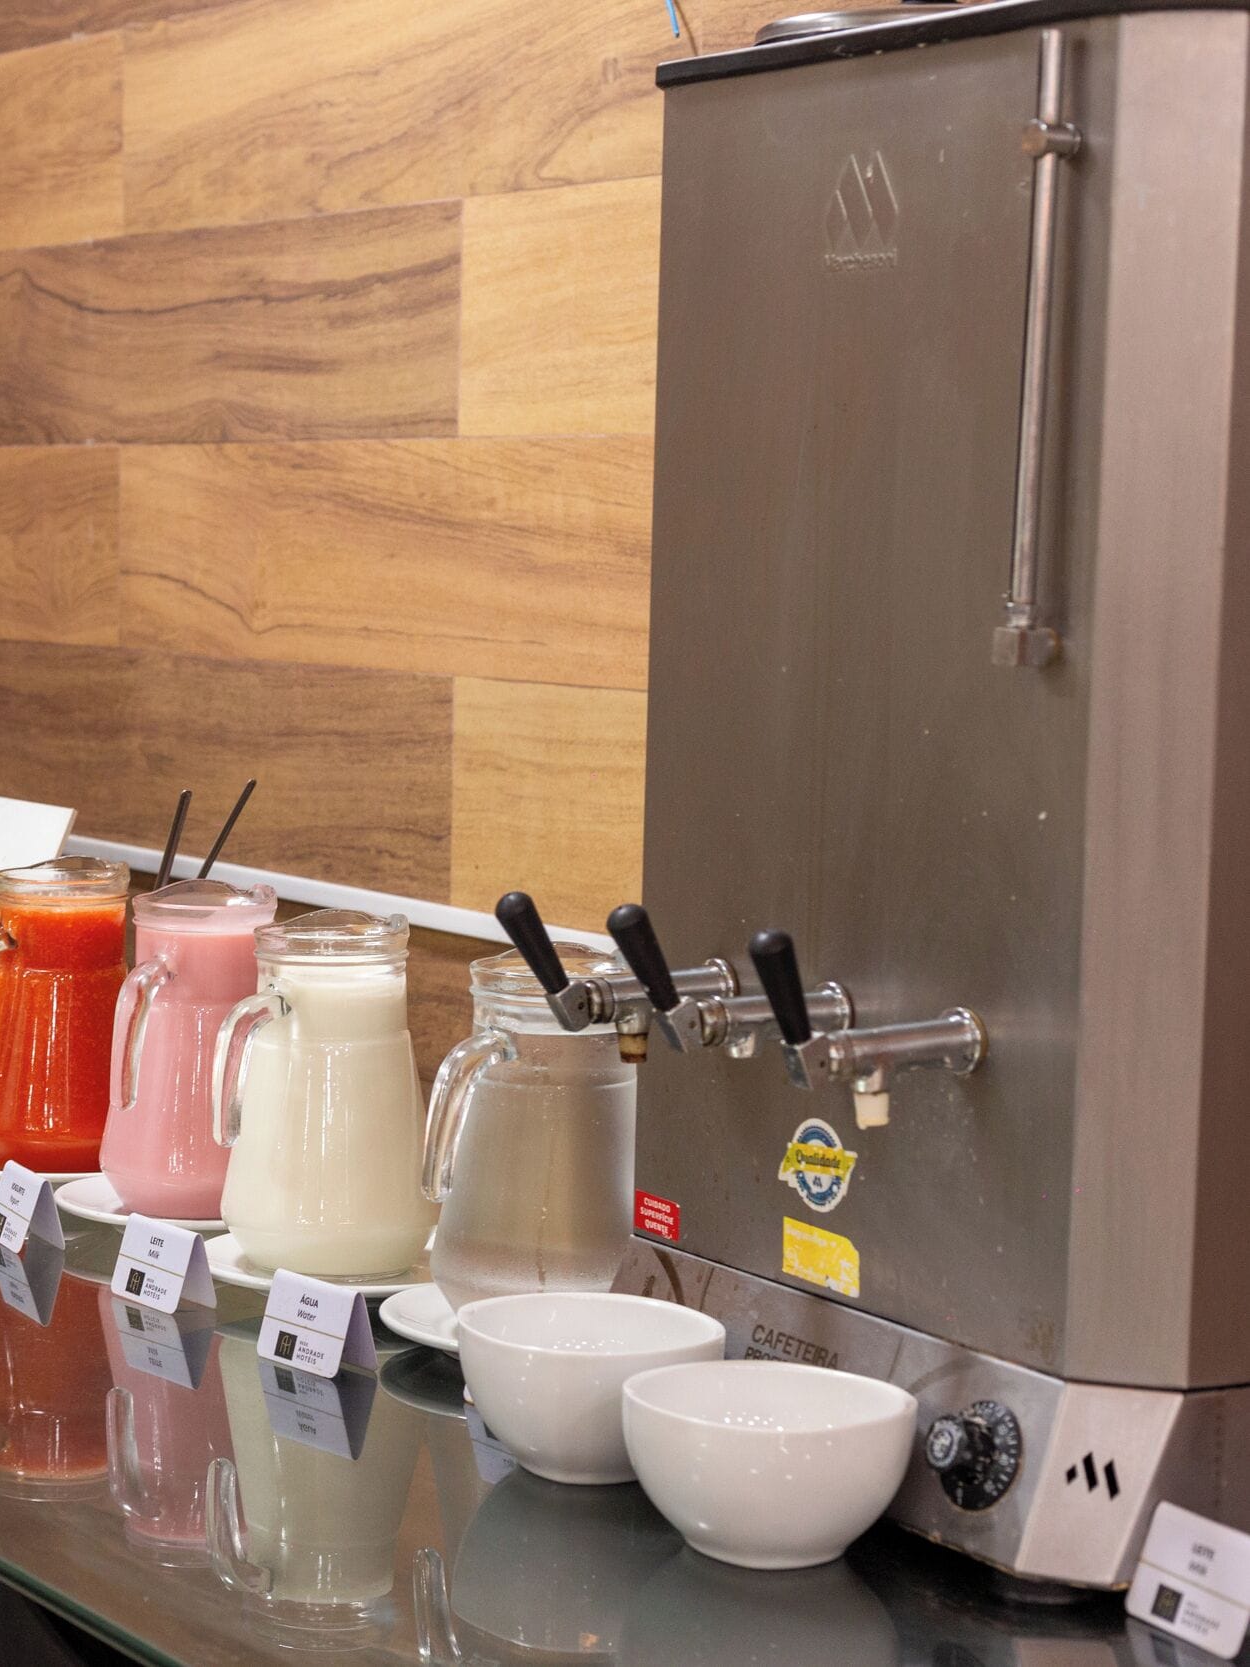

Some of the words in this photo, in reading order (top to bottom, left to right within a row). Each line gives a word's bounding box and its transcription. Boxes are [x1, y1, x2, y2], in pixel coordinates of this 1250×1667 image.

[796, 1149, 841, 1169] Qualidade
[644, 1197, 671, 1213] CUIDADO
[644, 1219, 669, 1234] QUENTE
[150, 1236, 165, 1248] LEITE
[145, 1282, 168, 1296] ANDRADE
[299, 1293, 319, 1308] ÁGUA
[297, 1309, 317, 1321] Water
[297, 1347, 325, 1360] ANDRADE
[751, 1324, 839, 1370] CAFETEIRA
